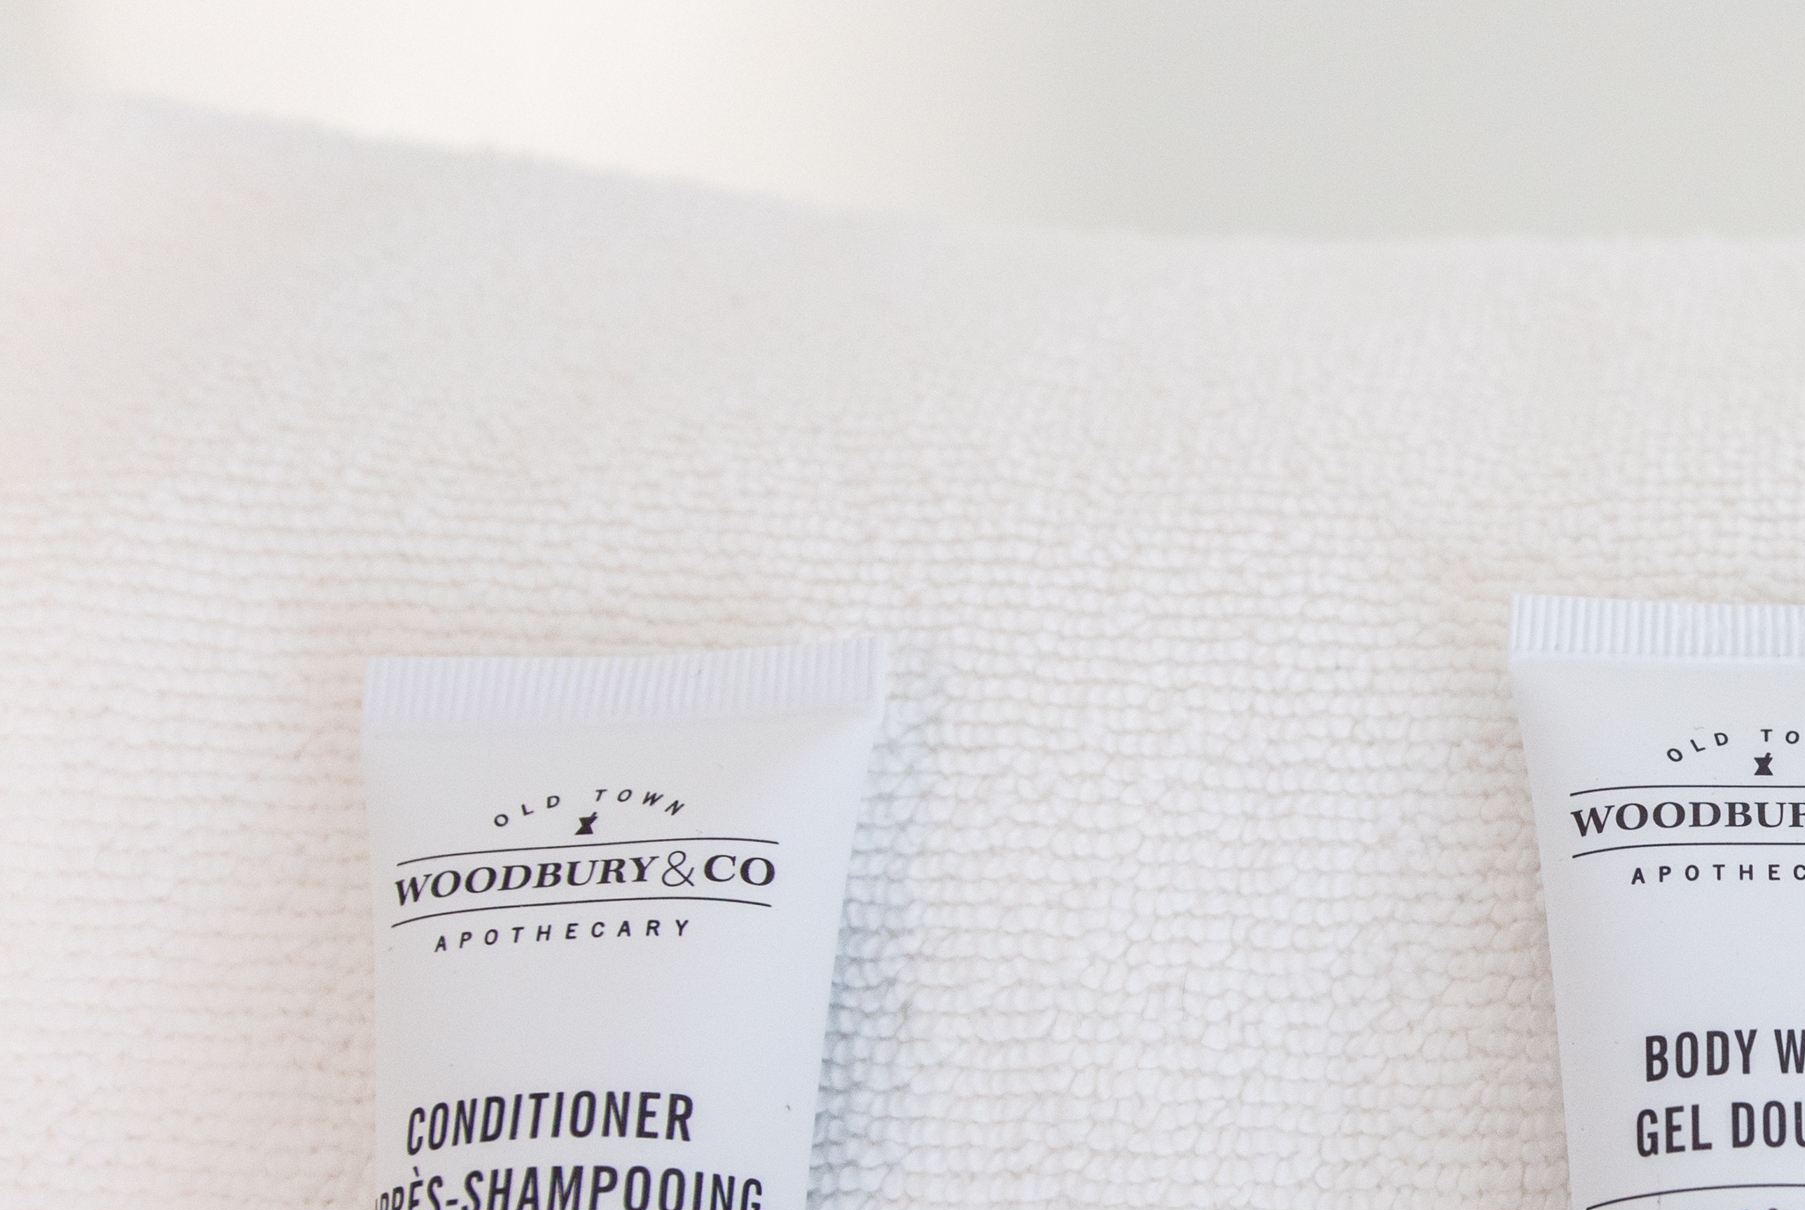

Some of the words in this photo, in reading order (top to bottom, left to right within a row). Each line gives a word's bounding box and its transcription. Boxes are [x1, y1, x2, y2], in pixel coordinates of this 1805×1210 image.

[1666, 732, 1728, 762] OLD
[493, 795, 561, 827] OLD
[594, 789, 685, 817] TOWN
[434, 919, 689, 953] APOTHECARY
[1645, 1028, 1758, 1082] BODY
[406, 1090, 693, 1156] CONDITIONER
[1636, 1104, 1712, 1158] GEL
